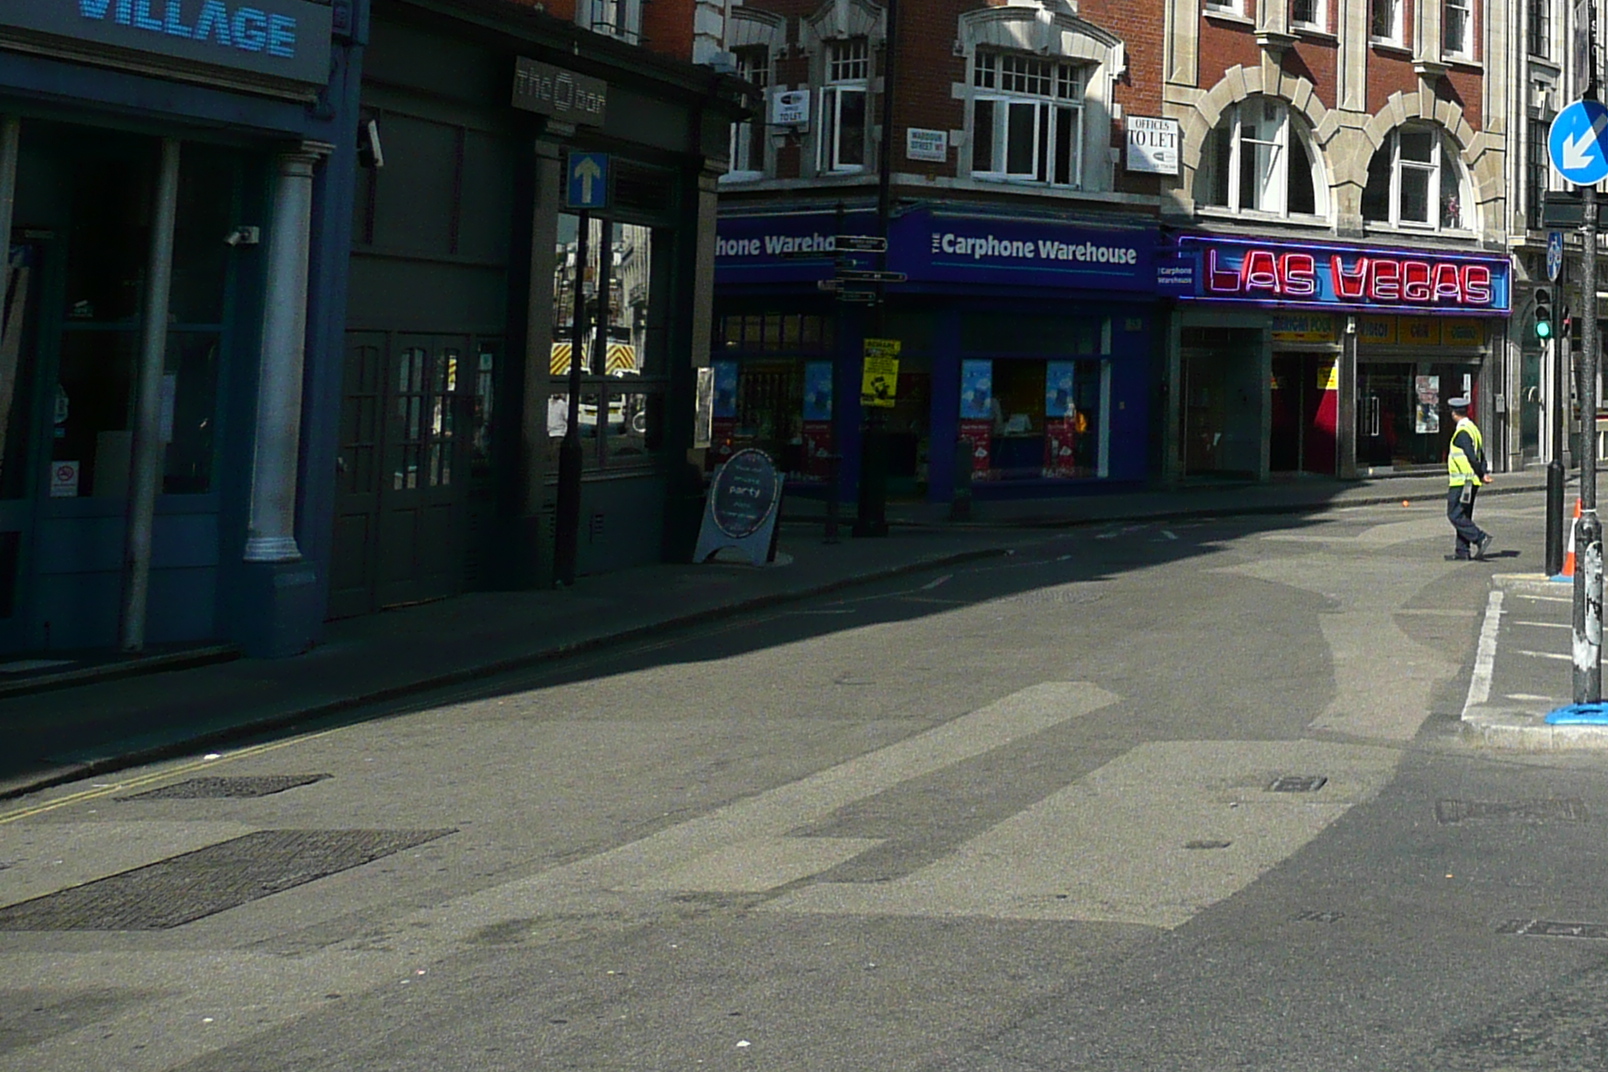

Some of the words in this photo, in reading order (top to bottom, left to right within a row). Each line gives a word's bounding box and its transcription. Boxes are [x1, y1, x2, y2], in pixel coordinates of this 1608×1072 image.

[1135, 118, 1170, 131] OFFICES
[1127, 129, 1146, 146] TO
[1149, 131, 1177, 148] LET
[942, 233, 1036, 260] Carphone
[1037, 239, 1138, 266] Warehouse
[1203, 247, 1318, 296] LAS
[1332, 253, 1493, 304] VEGAS
[728, 485, 761, 499] party
